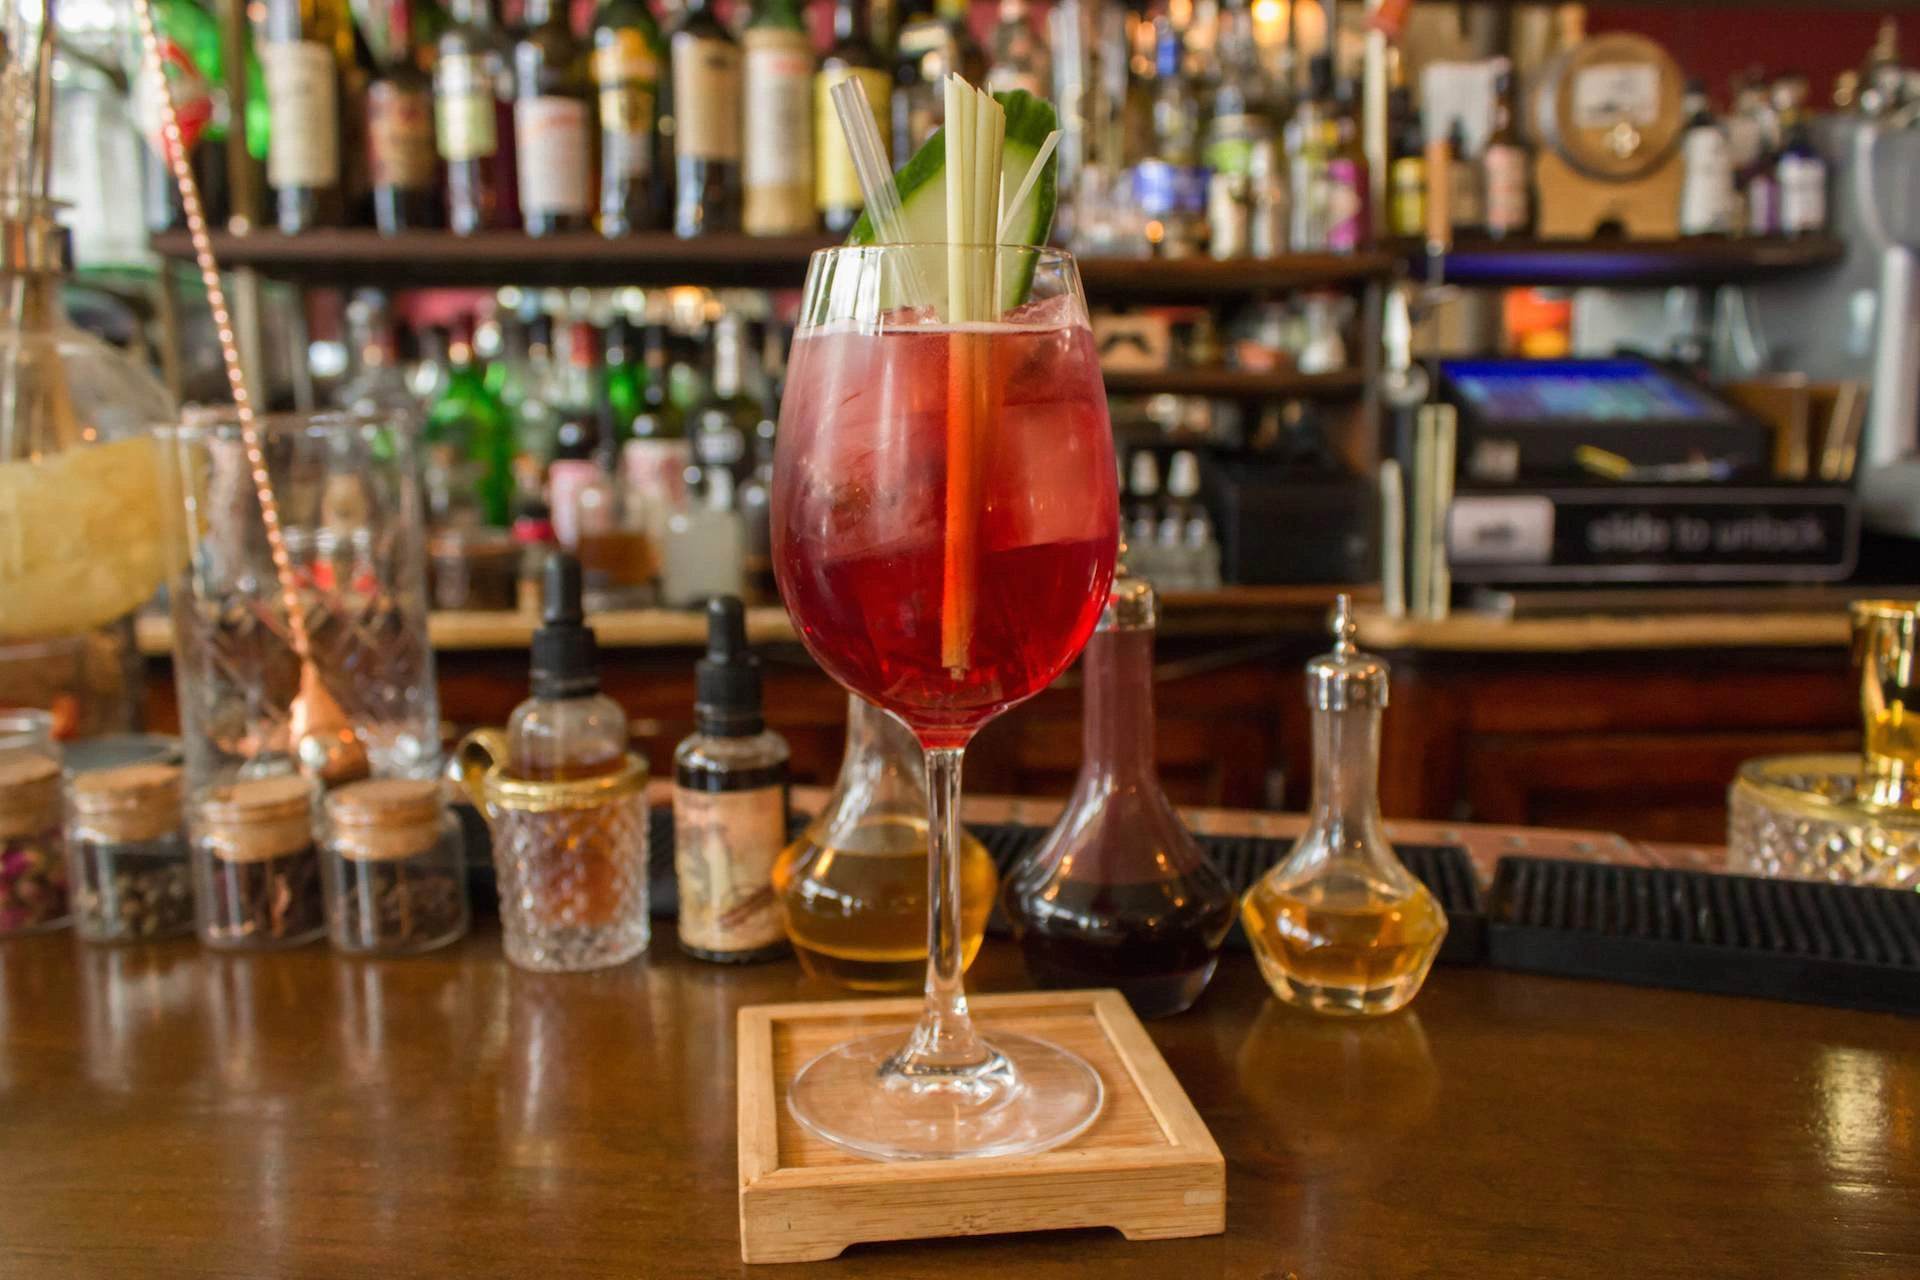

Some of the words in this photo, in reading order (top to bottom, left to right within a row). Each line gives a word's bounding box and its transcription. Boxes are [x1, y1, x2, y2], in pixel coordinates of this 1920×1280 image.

[1587, 514, 1669, 551] slide
[1676, 517, 1709, 551] to
[1715, 515, 1824, 551] unlock
